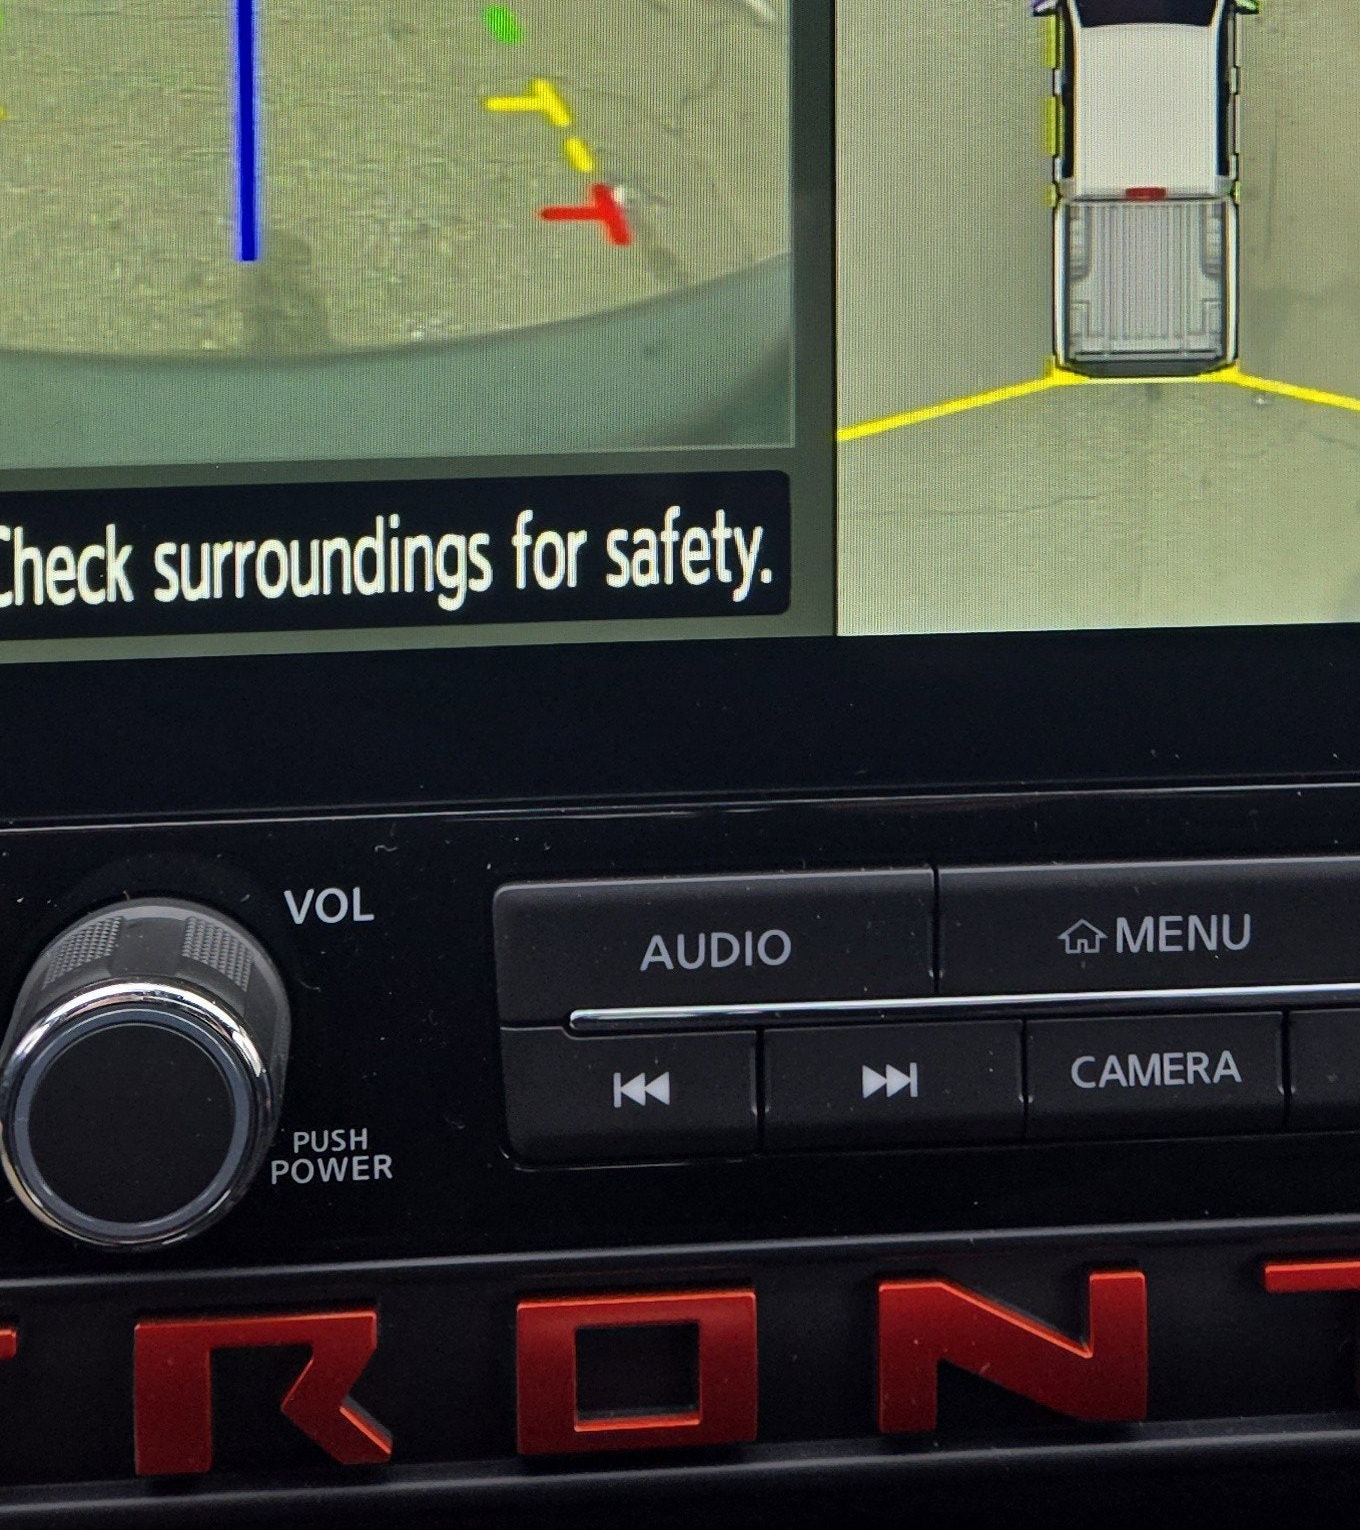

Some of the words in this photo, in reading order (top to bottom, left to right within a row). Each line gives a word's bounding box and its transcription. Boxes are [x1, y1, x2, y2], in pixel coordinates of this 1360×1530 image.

[153, 512, 493, 612] surroundings
[511, 509, 589, 590] for
[605, 505, 773, 603] safety.
[283, 887, 375, 925] VOL
[639, 929, 793, 972] AUDIO
[1115, 913, 1252, 954] MENU
[1070, 1050, 1243, 1090] CAMERA
[293, 1128, 370, 1152] PUSH
[271, 1153, 394, 1186] POWER
